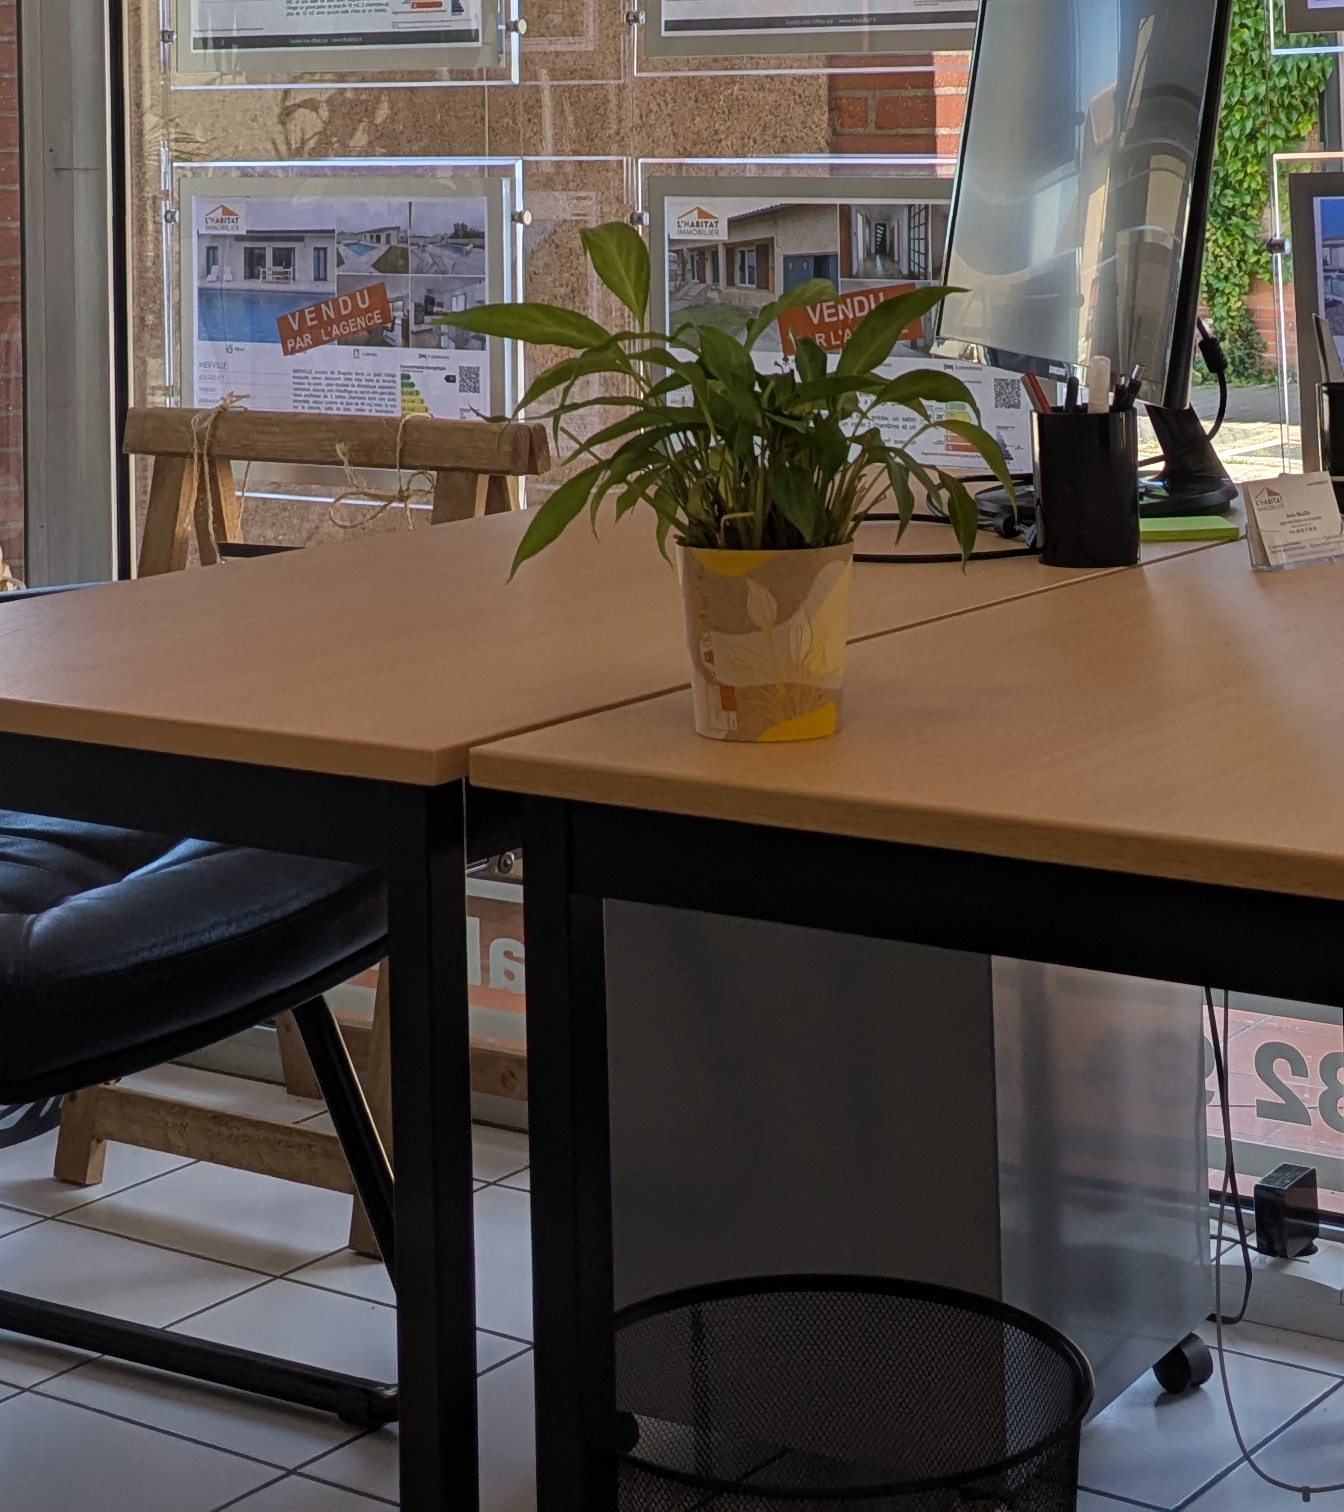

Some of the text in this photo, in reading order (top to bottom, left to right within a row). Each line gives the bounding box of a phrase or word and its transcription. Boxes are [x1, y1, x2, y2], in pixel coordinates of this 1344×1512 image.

[677, 220, 719, 228] L'HABITAT
[677, 228, 719, 236] IMMOBILIER
[288, 289, 370, 331] VENDU
[287, 310, 383, 352] PAR L'AGENCE
